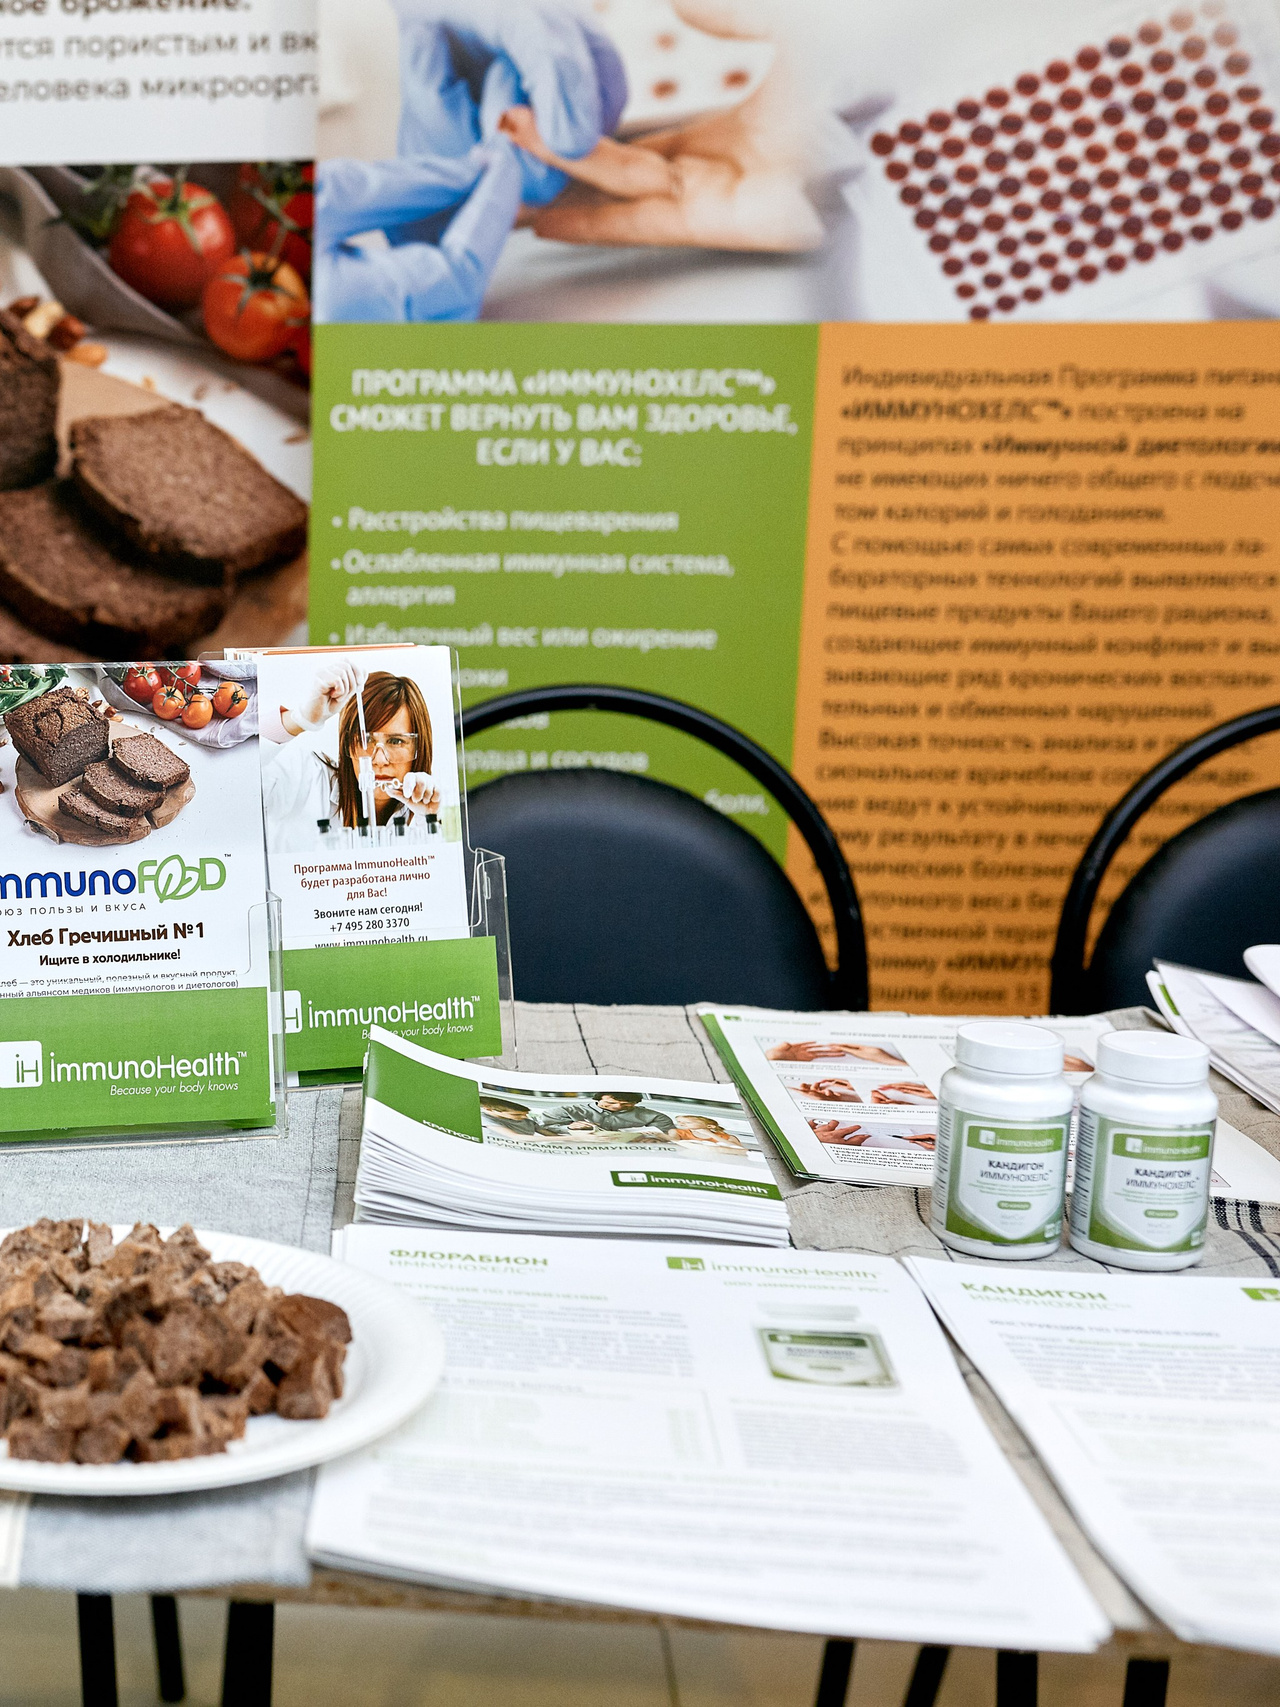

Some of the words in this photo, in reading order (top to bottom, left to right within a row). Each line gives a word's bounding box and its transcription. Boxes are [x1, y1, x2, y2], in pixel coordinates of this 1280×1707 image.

[65, 34, 239, 62] пористым
[249, 34, 270, 54] и
[351, 368, 517, 396] ПРОГРАММА
[329, 403, 446, 432] СМОЖЕТ
[450, 404, 572, 431] ВЕРНУТЬ
[577, 404, 638, 431] ВАМ
[644, 403, 798, 435] ЗДОРОВЬЕ,
[477, 438, 550, 466] ЕСЛИ
[554, 438, 576, 466] У
[580, 438, 642, 467] ВАС:
[348, 506, 507, 536] Расстройства
[510, 510, 680, 536] пищеварения
[342, 548, 500, 574] Ослабленная
[503, 552, 626, 578] иммунная
[629, 552, 735, 577] система,
[346, 585, 456, 608] аллергия
[345, 622, 493, 646] Избыточный
[497, 626, 536, 647] вес
[542, 627, 589, 647] или
[591, 627, 718, 653] ожирение
[294, 862, 352, 876] Программа
[301, 876, 330, 889] будет
[332, 873, 397, 886] разработана
[399, 871, 431, 882] лично
[347, 890, 365, 901] для
[368, 887, 388, 898] Вас!
[29, 905, 84, 915] ПОЛЬЗЫ
[90, 904, 99, 913] И
[105, 903, 147, 912] ВКУСА
[314, 908, 356, 920] Звоните
[358, 906, 378, 916] нам
[380, 902, 423, 916] сегодня!
[329, 922, 343, 933] +7
[345, 920, 363, 931] 495
[366, 919, 384, 930] 280
[385, 917, 410, 929] 3370
[7, 927, 54, 948] Хлеб
[58, 923, 168, 947] Гречишный
[39, 952, 80, 967] Ищите
[82, 954, 90, 964] в
[92, 948, 181, 964] холодильнике!
[26, 988, 69, 999] альянсом
[72, 985, 111, 996] медиков
[113, 982, 176, 996] (иммунологов
[186, 979, 239, 992] диетологов)
[401, 1028, 420, 1039] your
[422, 1024, 445, 1037] body
[447, 1023, 474, 1034] knows
[110, 1083, 152, 1097] Because
[154, 1084, 176, 1097] your
[179, 1080, 204, 1095] body
[208, 1080, 239, 1092] knows
[422, 1119, 481, 1143] КРАТКОЕ
[487, 1135, 574, 1152] ПРОГРАММА
[988, 1159, 1045, 1171] КАНДИГОН
[1134, 1168, 1192, 1180] КАНДИГОН
[389, 1249, 549, 1266] ФЛОРАБИОН
[961, 1281, 1108, 1301] КАНДИГОН
